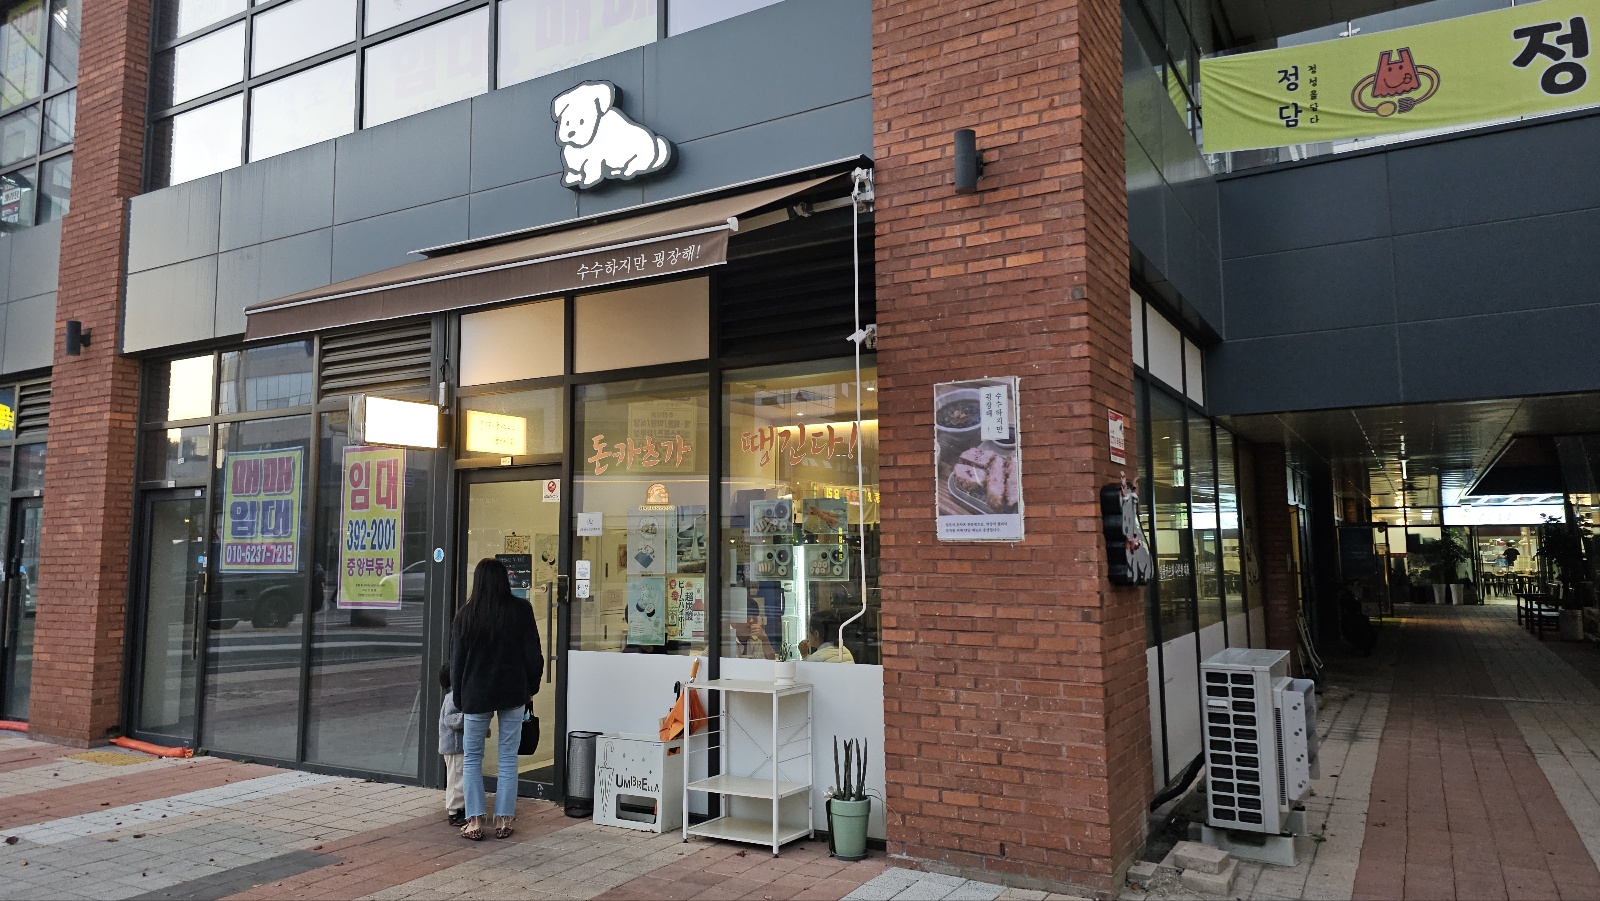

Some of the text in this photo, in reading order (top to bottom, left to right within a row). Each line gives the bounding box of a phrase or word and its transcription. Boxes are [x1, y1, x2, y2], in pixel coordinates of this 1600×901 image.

[1512, 16, 1590, 95] 정
[1277, 65, 1303, 128] 정담
[576, 244, 701, 281] 수수하지만 굉장해!
[995, 392, 1003, 434] 수수하지만
[588, 434, 692, 476] 돈카츠가
[741, 421, 858, 468] 땡긴다!
[231, 456, 295, 497] 매매
[349, 458, 399, 511] 임대
[229, 499, 293, 539] 임대
[346, 518, 397, 551] 392-2001
[226, 544, 293, 564] 010-6237-7215
[346, 557, 394, 578] 중앙부동산
[615, 774, 660, 793] UMBRELLA
